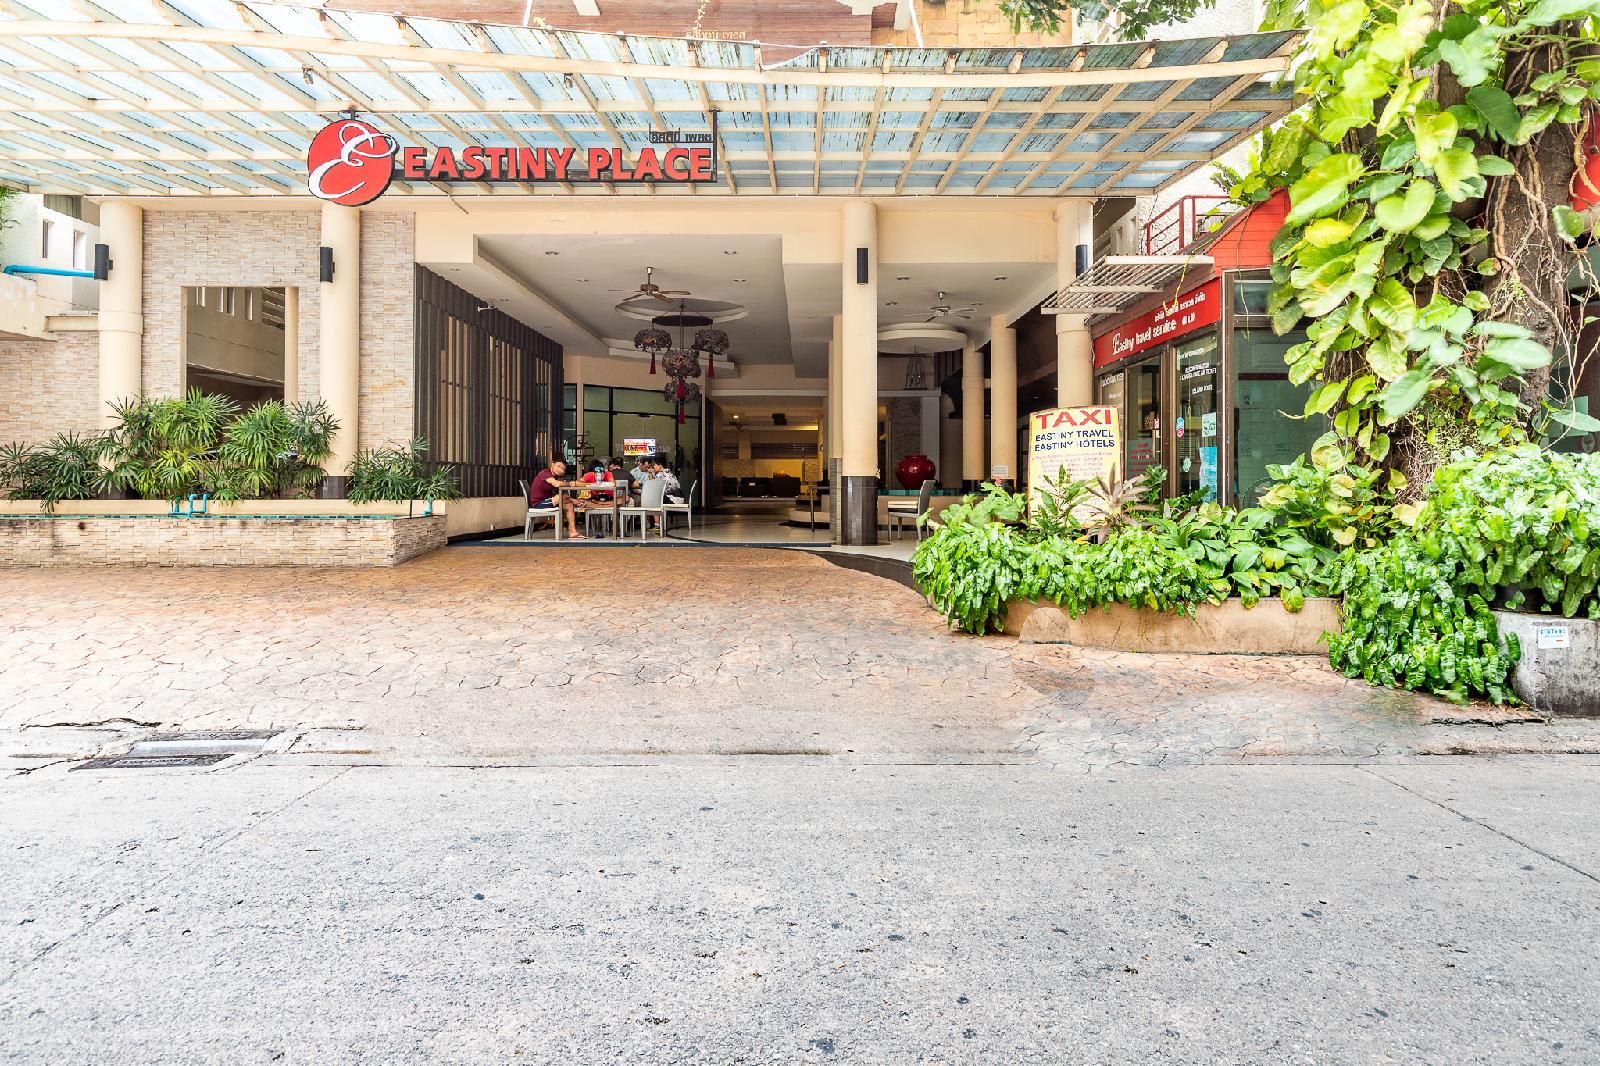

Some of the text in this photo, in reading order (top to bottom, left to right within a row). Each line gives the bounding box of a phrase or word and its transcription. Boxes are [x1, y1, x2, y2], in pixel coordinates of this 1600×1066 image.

[404, 146, 712, 180] EASTINY PLACE
[1112, 332, 1135, 356] Eastiny
[1136, 327, 1152, 345] travel
[1153, 319, 1177, 338] service
[1036, 409, 1112, 429] TAXI
[1034, 439, 1115, 451] EASTINY HOTELS
[1035, 430, 1114, 441] EASTINY TRAVEL
